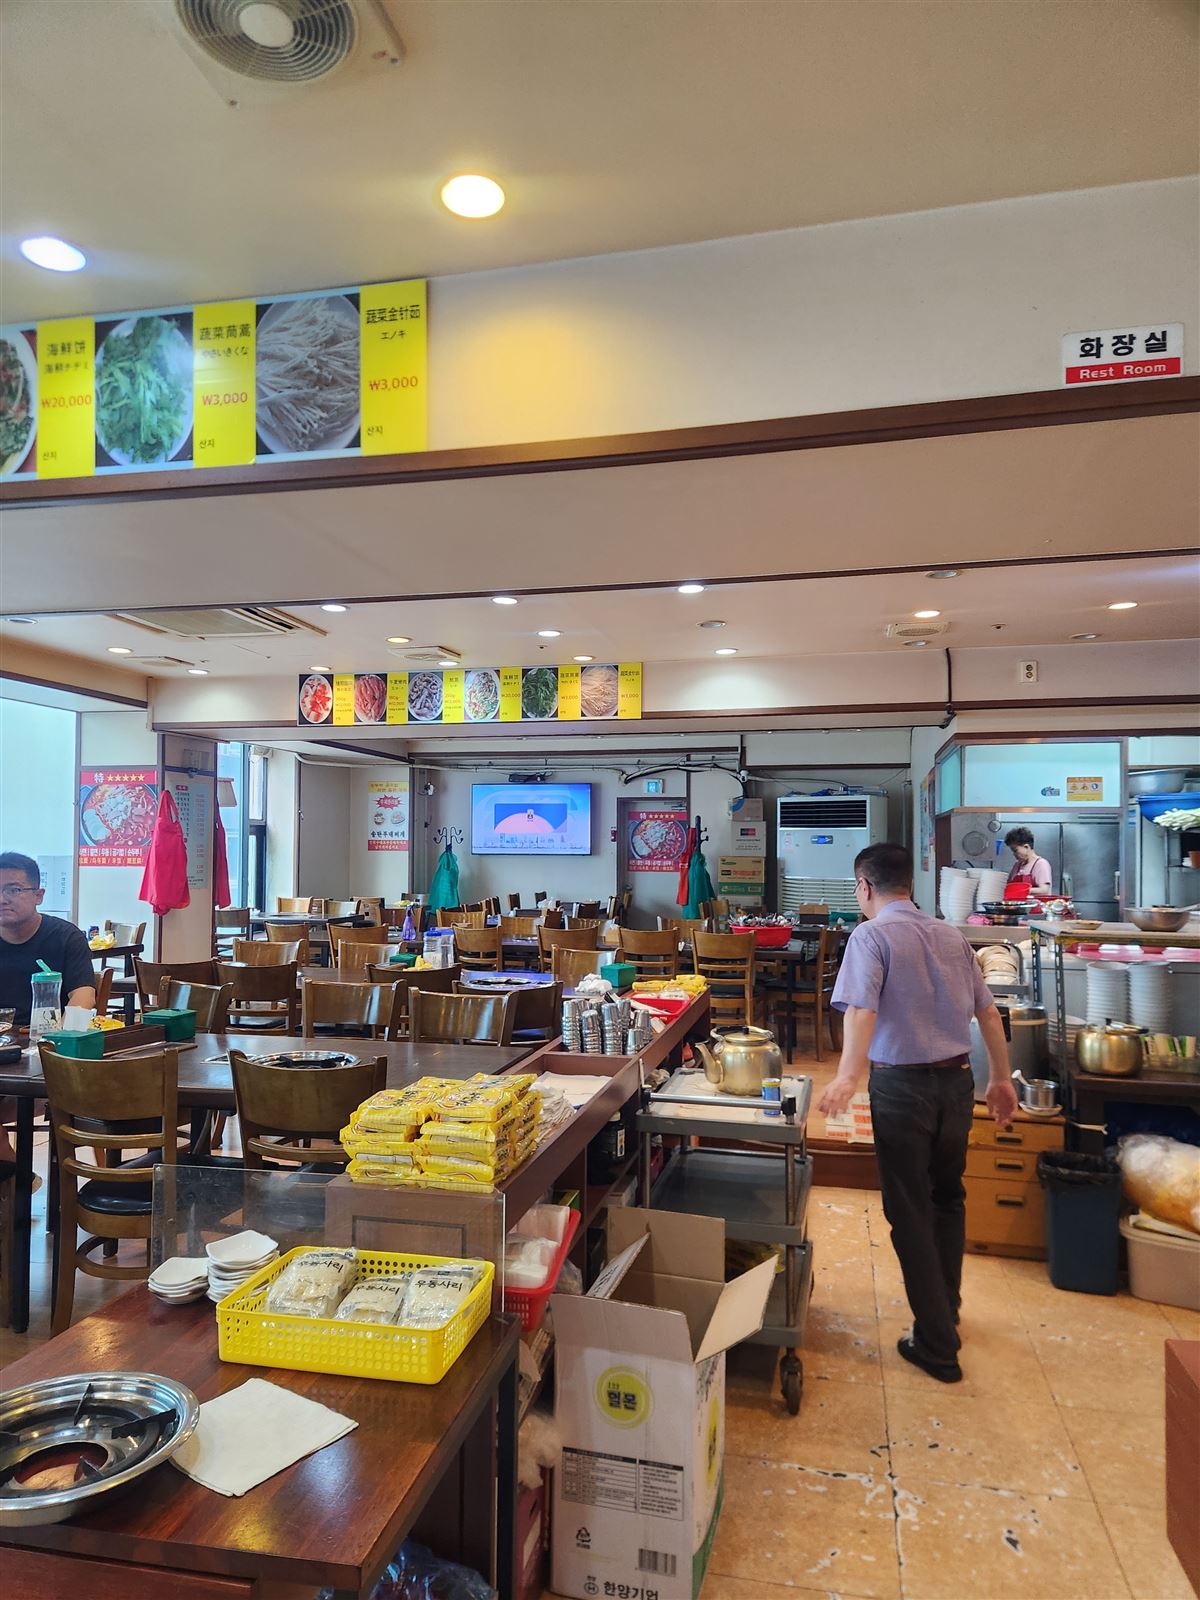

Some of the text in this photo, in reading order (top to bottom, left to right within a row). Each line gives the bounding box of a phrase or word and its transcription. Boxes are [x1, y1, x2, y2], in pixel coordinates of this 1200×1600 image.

[1079, 330, 1167, 358] 화장실
[1080, 364, 1167, 379] Rest Room
[415, 1279, 463, 1292] 우동사리
[603, 1581, 658, 1600] 한양기업
